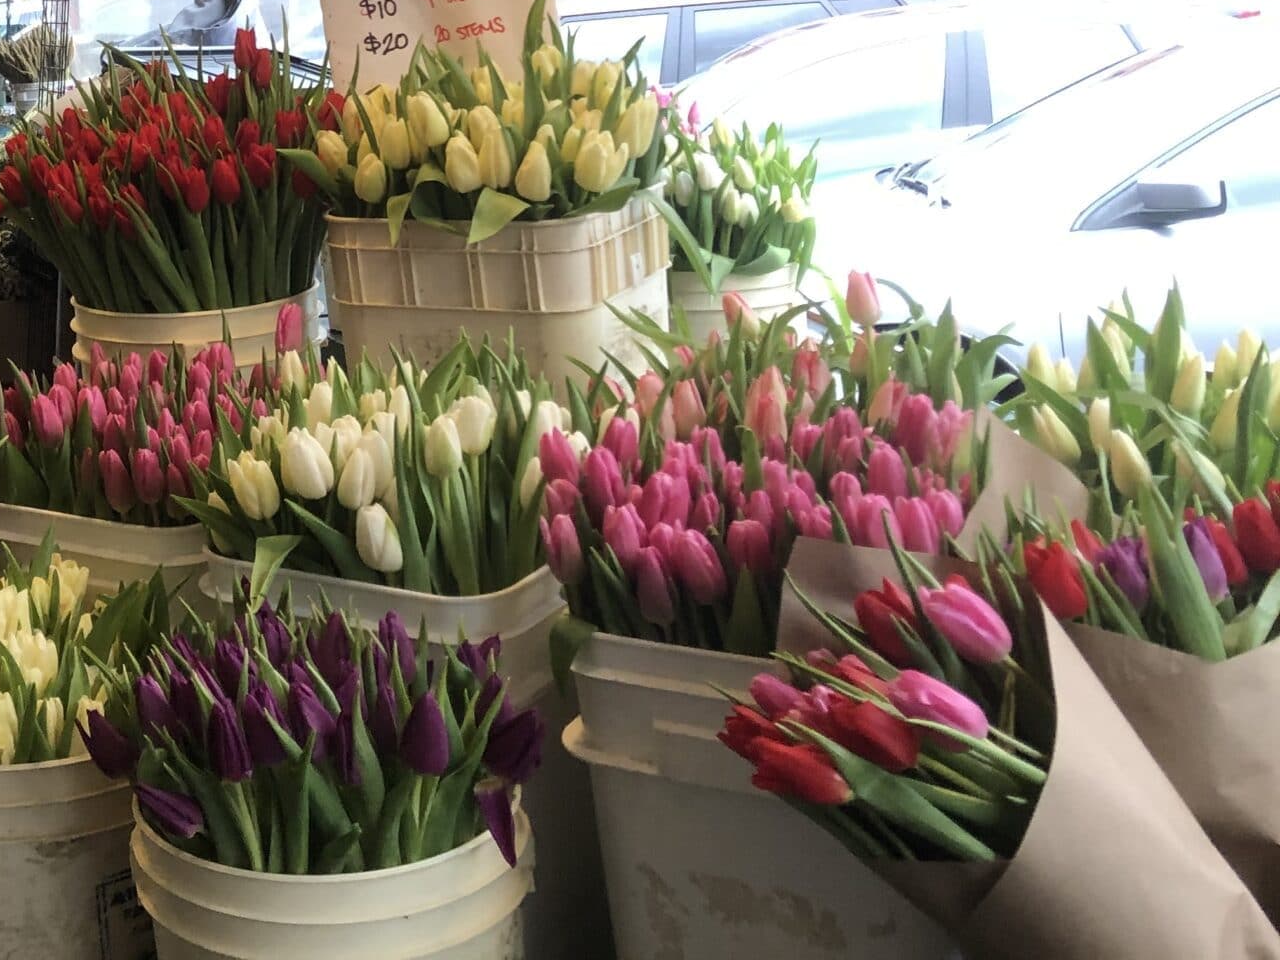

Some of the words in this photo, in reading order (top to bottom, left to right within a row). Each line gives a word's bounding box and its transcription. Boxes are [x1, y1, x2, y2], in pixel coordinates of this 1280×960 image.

[363, 32, 410, 56] $20
[433, 24, 452, 42] 20
[456, 16, 507, 41] STEMS
